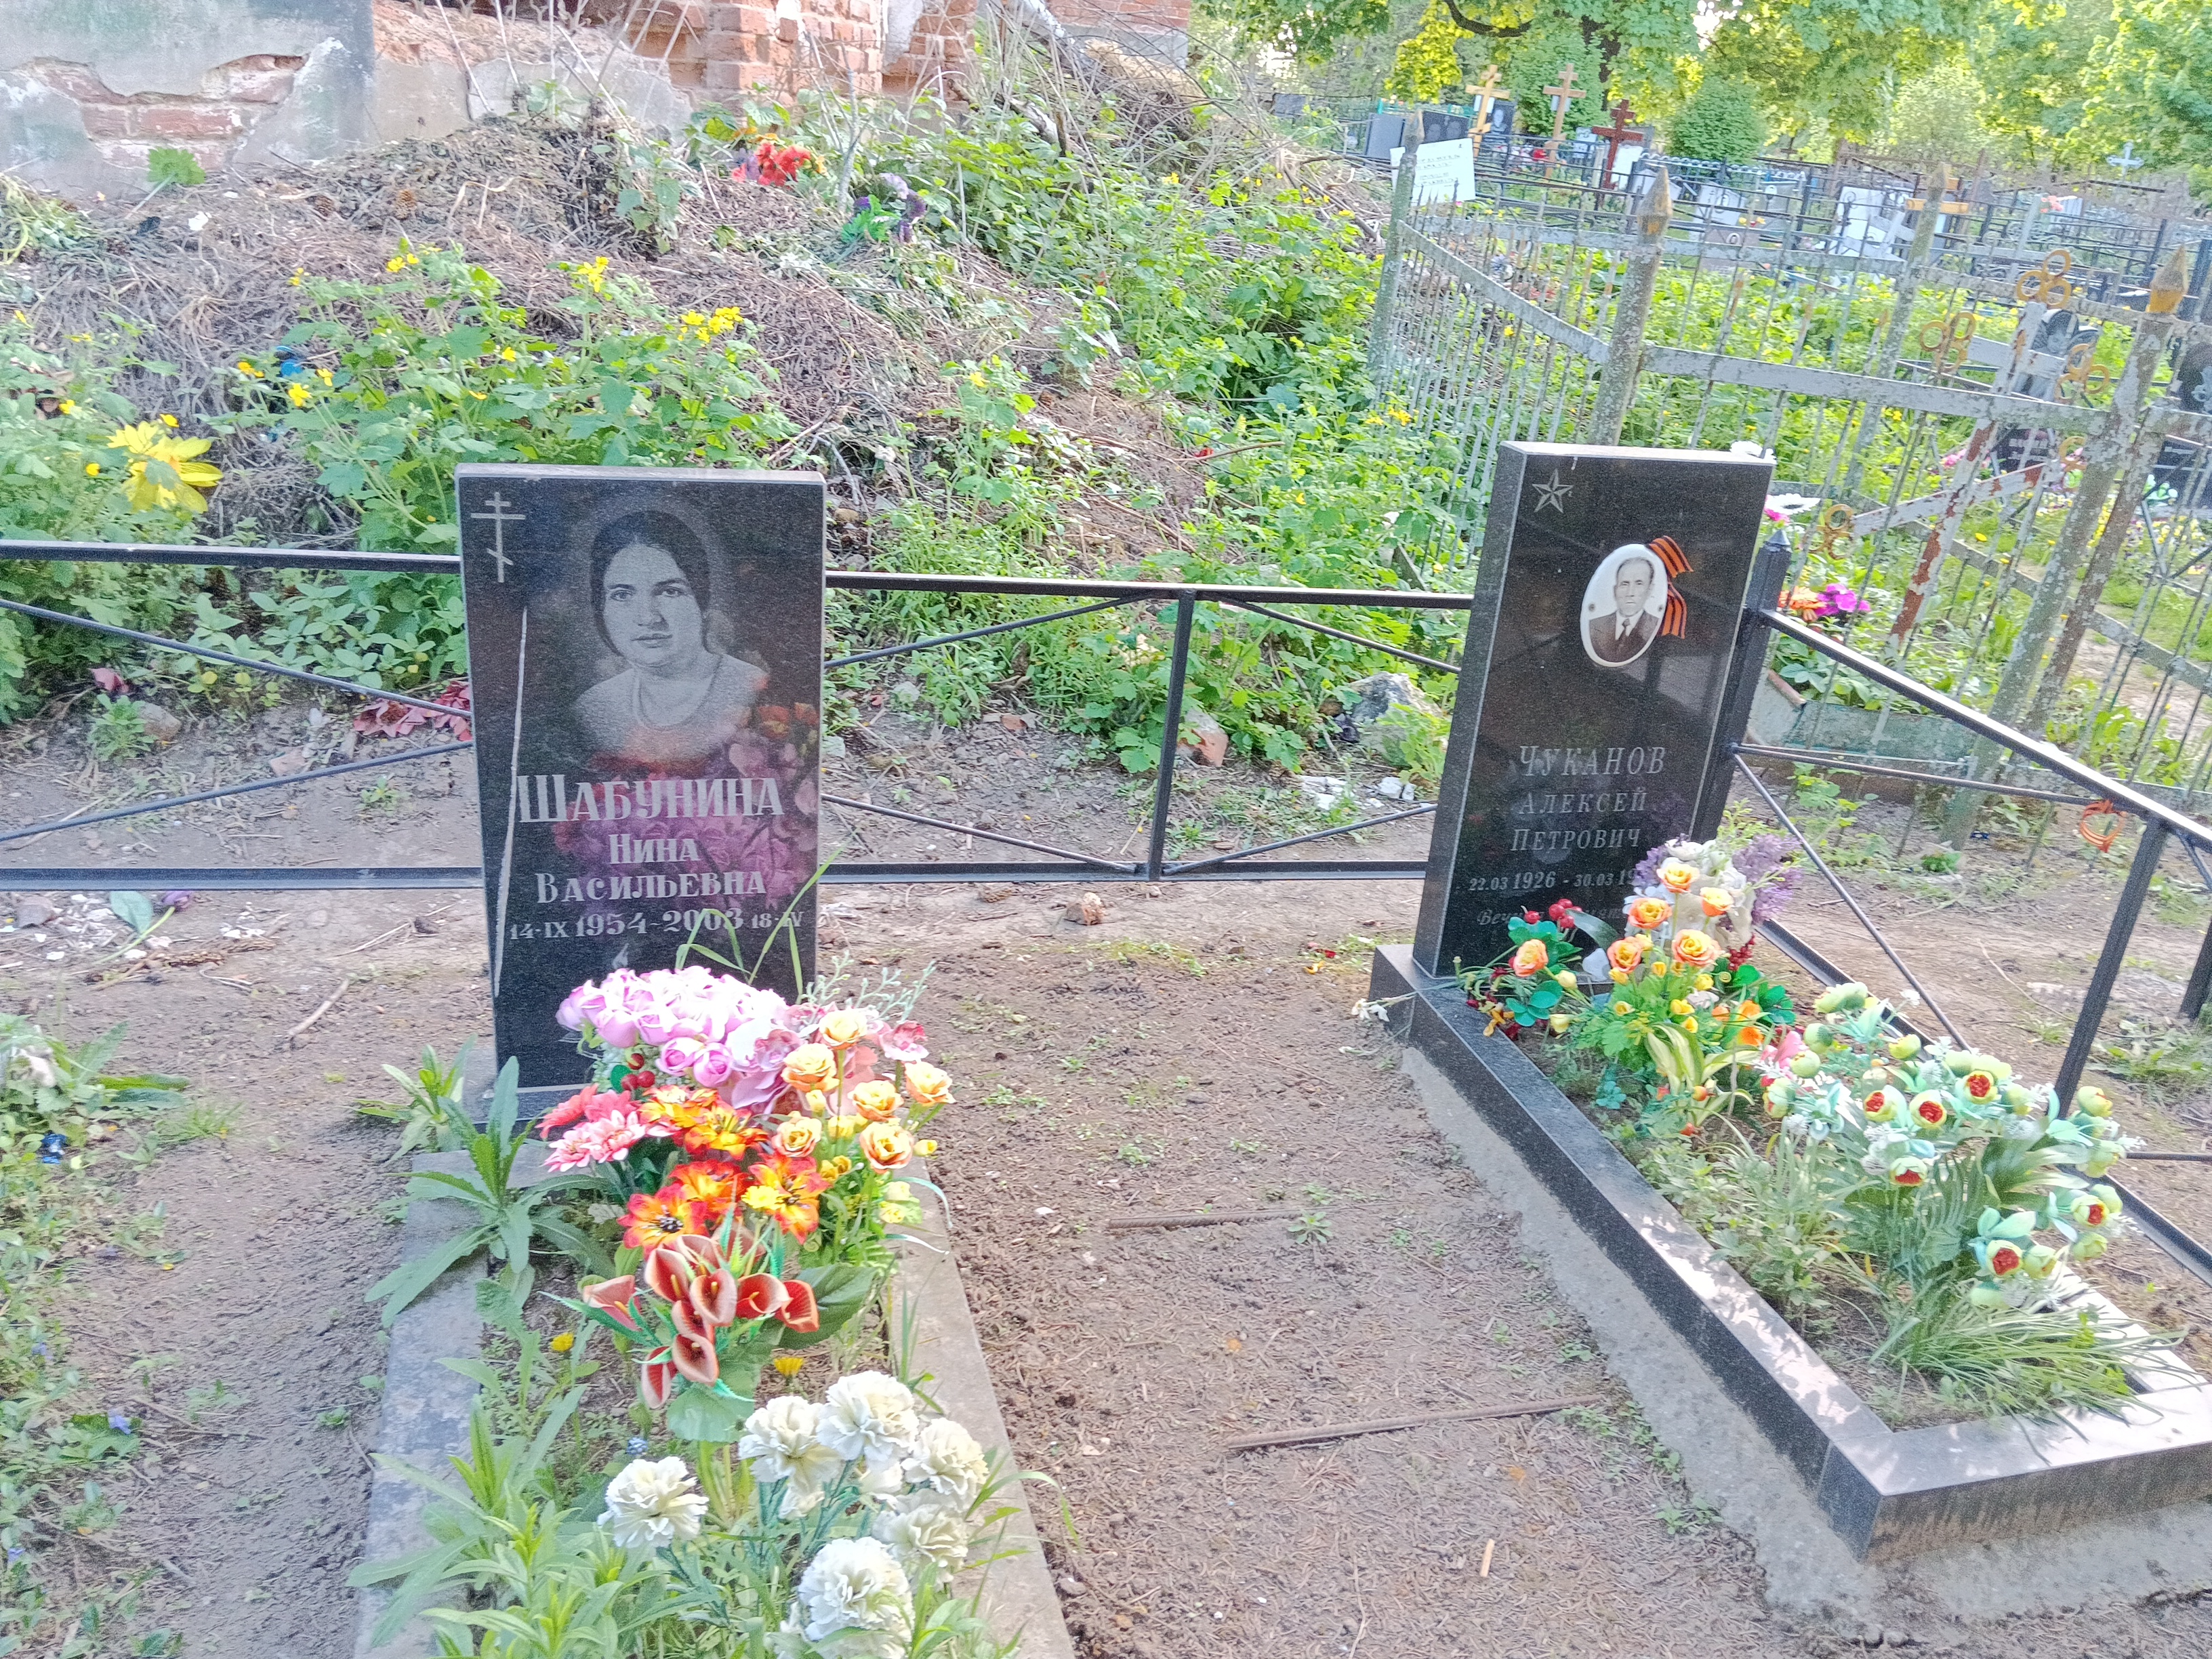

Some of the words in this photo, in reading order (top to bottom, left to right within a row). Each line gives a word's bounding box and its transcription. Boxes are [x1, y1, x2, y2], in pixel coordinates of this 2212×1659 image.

[1520, 745, 1666, 777] ЧУКАНОВ
[517, 774, 785, 822] ШАБУНИНА
[1519, 787, 1647, 814] АЛЕКСЕЙ
[609, 834, 701, 864] НИНА
[1510, 828, 1641, 851] ПЕТРОВИЧ
[535, 871, 767, 903] ВАСИЛЬЕВНА
[1468, 877, 1508, 891] 22.03
[1513, 872, 1557, 890] 1926
